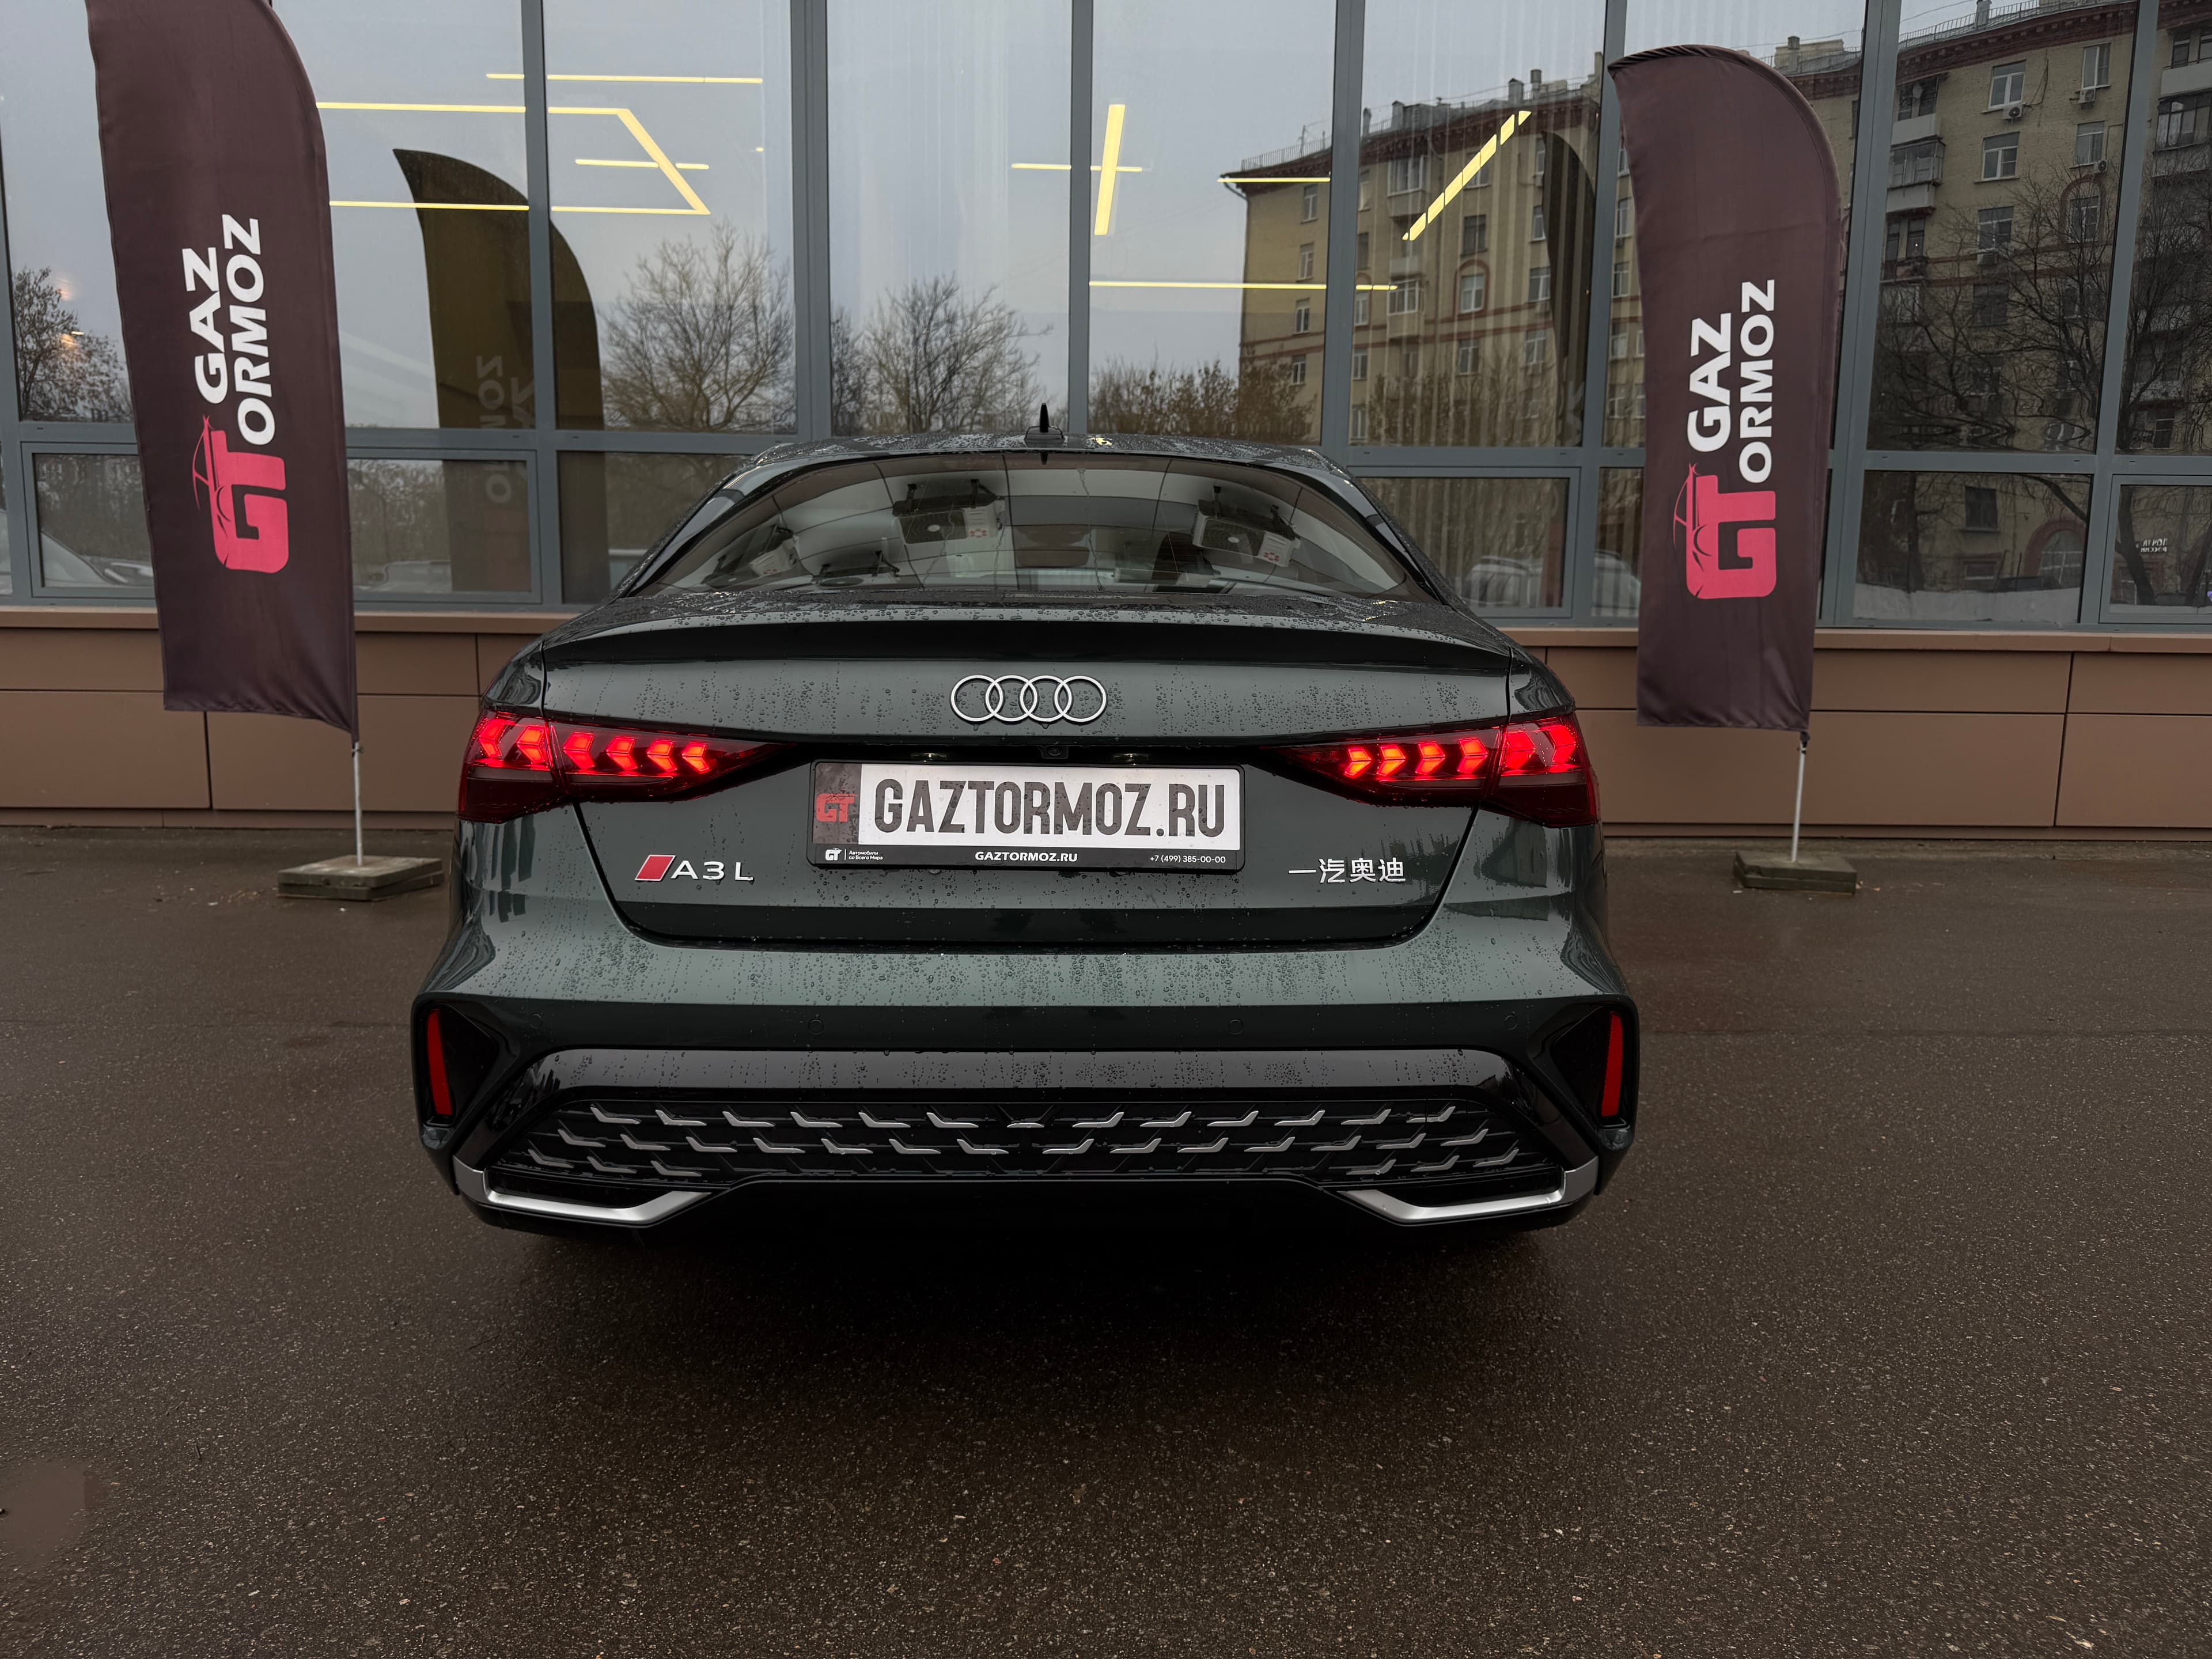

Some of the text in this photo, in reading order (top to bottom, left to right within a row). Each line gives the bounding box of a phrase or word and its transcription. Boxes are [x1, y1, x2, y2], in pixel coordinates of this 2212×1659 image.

[183, 248, 228, 403] GAZ
[1688, 313, 1731, 452] GAZ
[202, 421, 289, 573] GT
[1681, 469, 1777, 599] GT
[816, 793, 856, 823] GT
[874, 778, 1225, 838] GAZTORMOZ.RU
[825, 848, 842, 861] GT
[975, 851, 1078, 862] GAZTORMOZ.RU
[1161, 854, 1181, 863] (499)
[1183, 855, 1226, 863] 385-00-00
[671, 860, 754, 881] A3 L
[1288, 858, 1407, 884] 一汽奥迪
